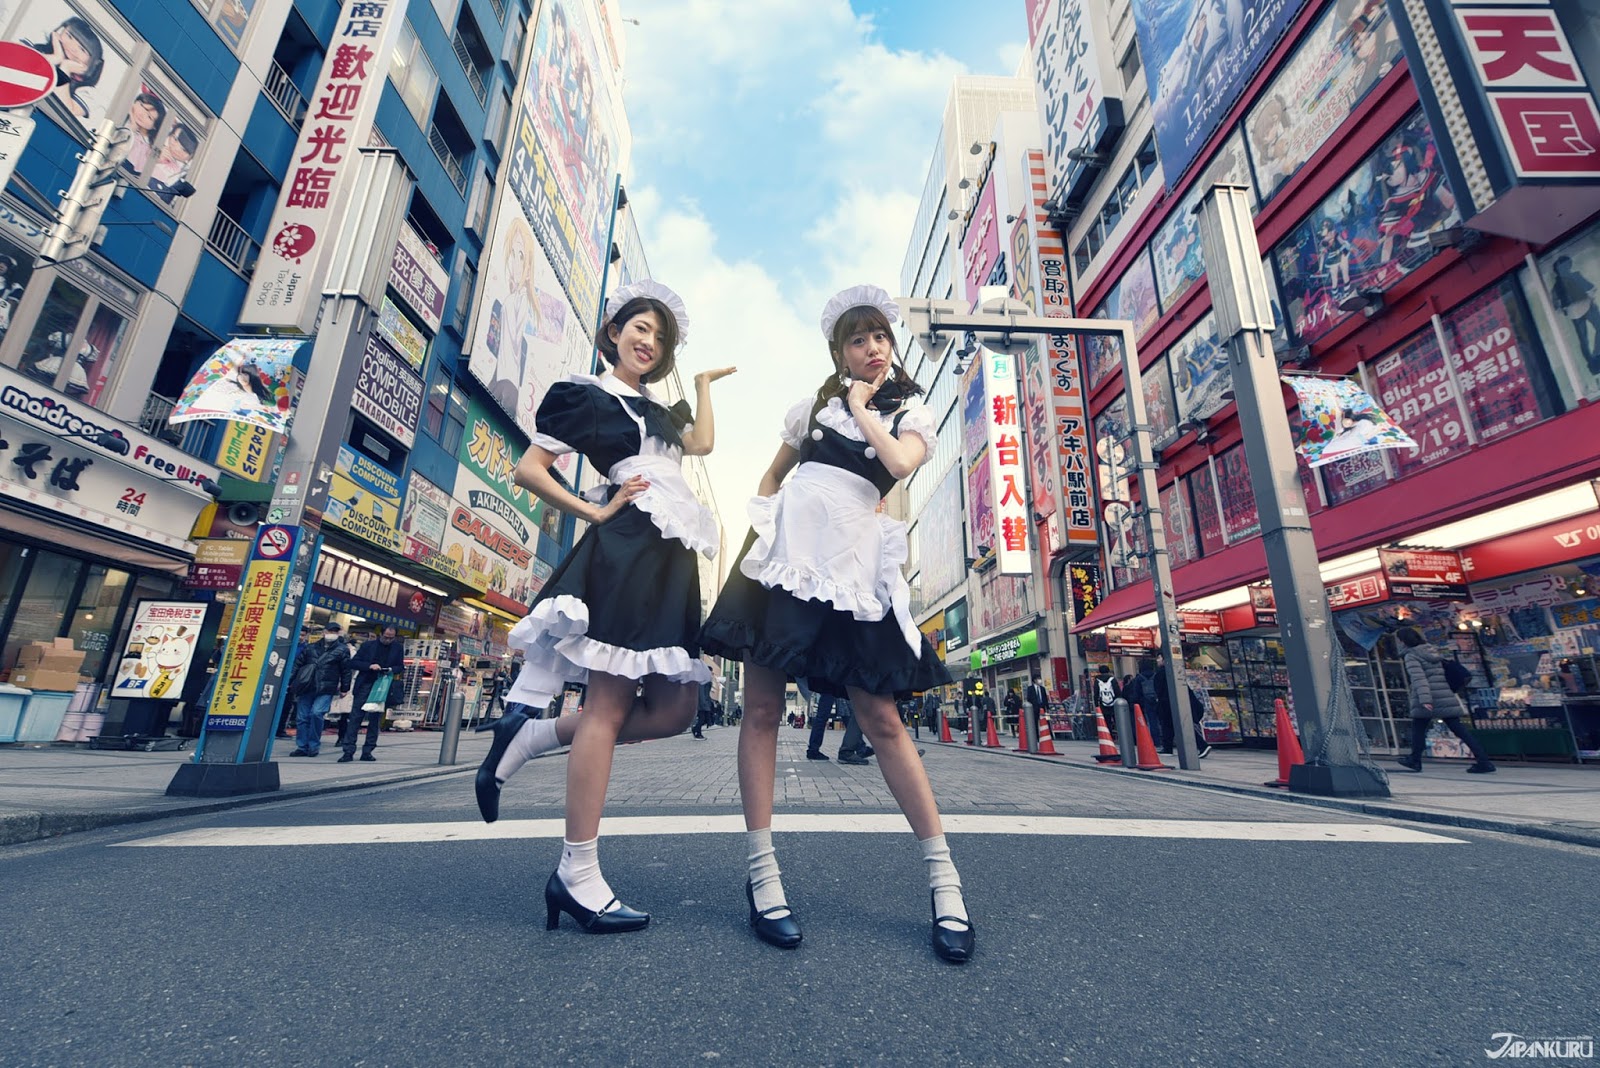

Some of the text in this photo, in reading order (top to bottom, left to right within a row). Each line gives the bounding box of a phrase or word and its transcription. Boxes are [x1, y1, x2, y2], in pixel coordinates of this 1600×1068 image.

[257, 281, 273, 307] Shop
[270, 269, 290, 307] Tax-free
[283, 273, 301, 306] Japan.
[1042, 259, 1065, 306] 買取り
[1296, 301, 1331, 338] アリス
[367, 338, 399, 376] English
[1463, 327, 1511, 363] DVD
[358, 373, 417, 430] & MOBILE
[363, 354, 420, 414] COMPUTER
[1, 385, 130, 456] maidrea
[356, 393, 396, 432] TAKARADA
[134, 445, 176, 477] Free
[358, 456, 397, 486] DISCOUNT
[993, 395, 1028, 552] 新台入替
[1061, 418, 1090, 527] アキバ駅前店
[120, 488, 146, 506] 24
[352, 464, 399, 498] COMPUTERS
[115, 501, 142, 518] 時間
[349, 508, 391, 536] DISCOUNT
[476, 492, 525, 540] AKIHABARA
[341, 517, 392, 548] COMPUTERS
[451, 506, 533, 570] GAMERS
[428, 548, 456, 567] DISCOUNT
[313, 553, 399, 608] TAKARADA
[1445, 572, 1462, 583] 4F
[226, 571, 274, 710] 路上喫煙禁止です。
[127, 680, 142, 688] BF
[216, 718, 247, 726] 千代田区
